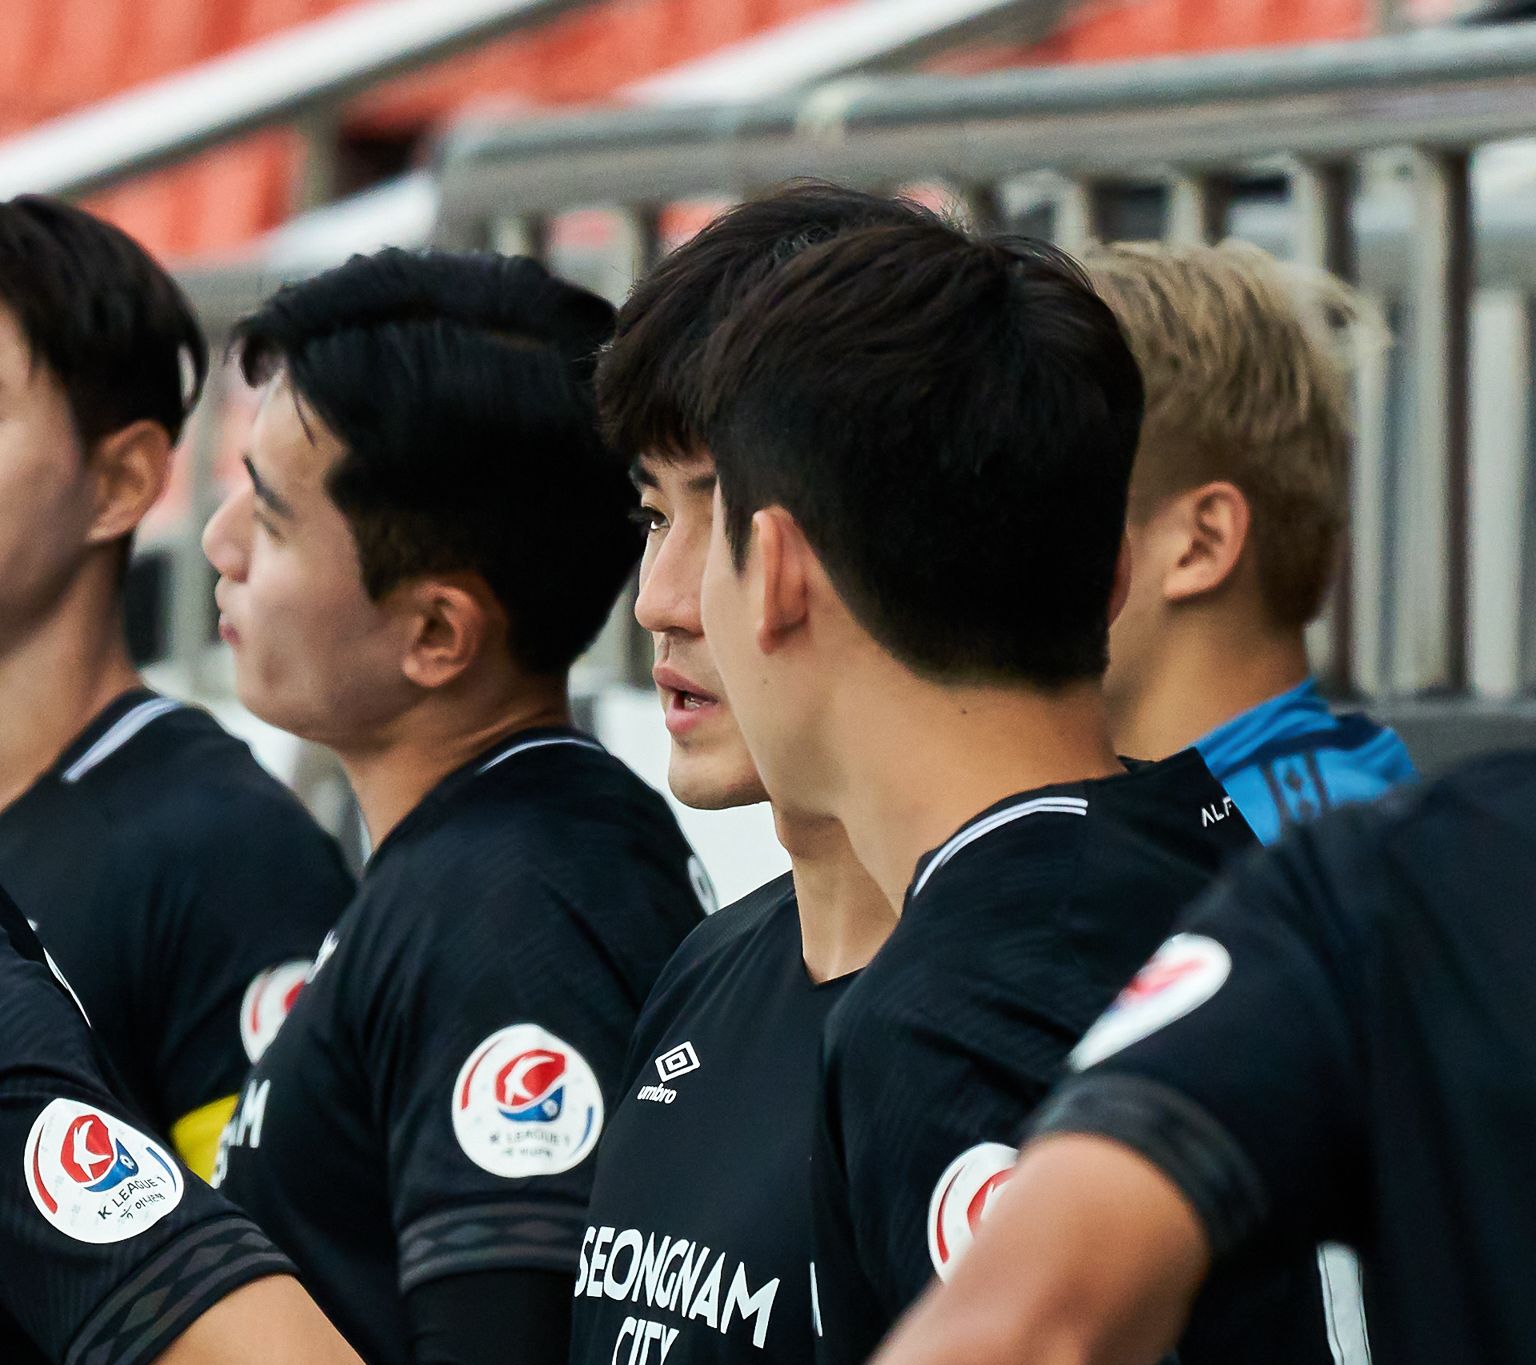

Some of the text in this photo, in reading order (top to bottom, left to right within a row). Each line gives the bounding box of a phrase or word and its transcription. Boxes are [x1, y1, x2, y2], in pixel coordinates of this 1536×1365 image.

[637, 1083, 677, 1104] umbro
[97, 1205, 112, 1220] K
[111, 1178, 158, 1208] LEAGUE
[574, 1225, 781, 1350] SEONGNAM
